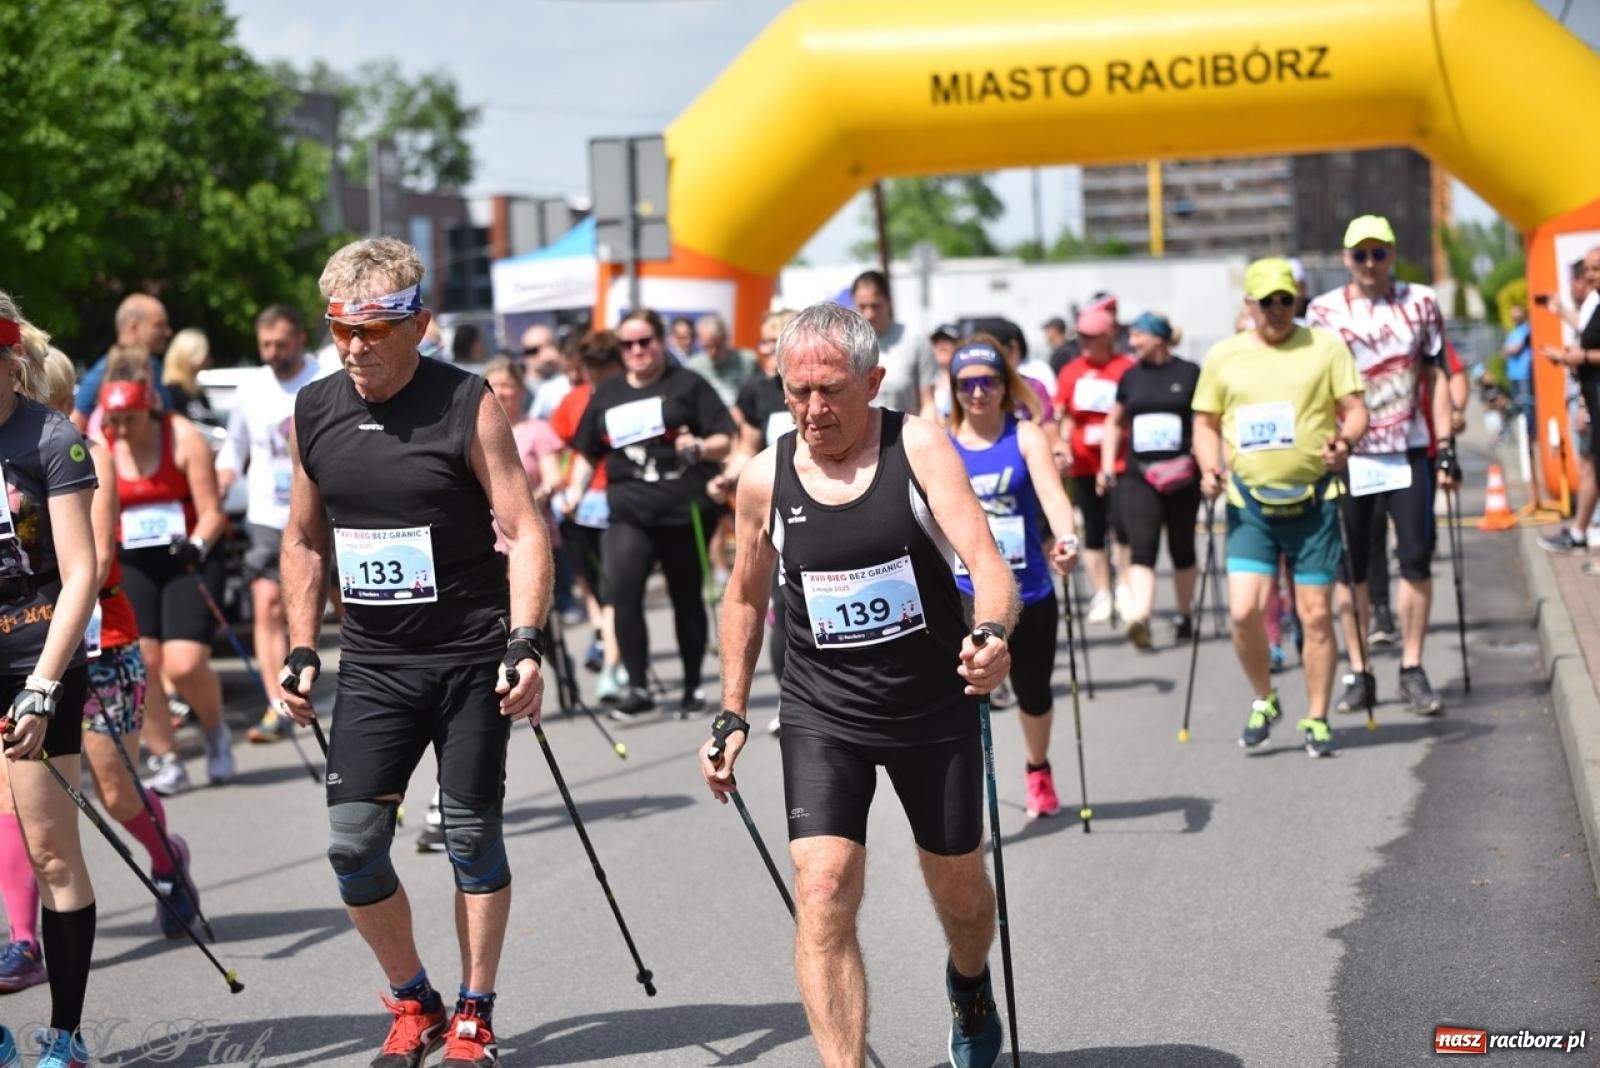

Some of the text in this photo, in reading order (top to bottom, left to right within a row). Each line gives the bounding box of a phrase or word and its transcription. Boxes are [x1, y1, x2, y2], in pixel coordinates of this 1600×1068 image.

[931, 43, 1331, 106] MIASTO RACIBÓRZ
[1250, 422, 1277, 437] 129
[371, 532, 388, 540] BEZ
[389, 529, 422, 540] GRANIC
[359, 560, 404, 585] 133
[827, 574, 848, 583] BIEG
[849, 571, 866, 581] BEZ
[868, 560, 904, 578] GRANIC
[835, 597, 891, 628] 139
